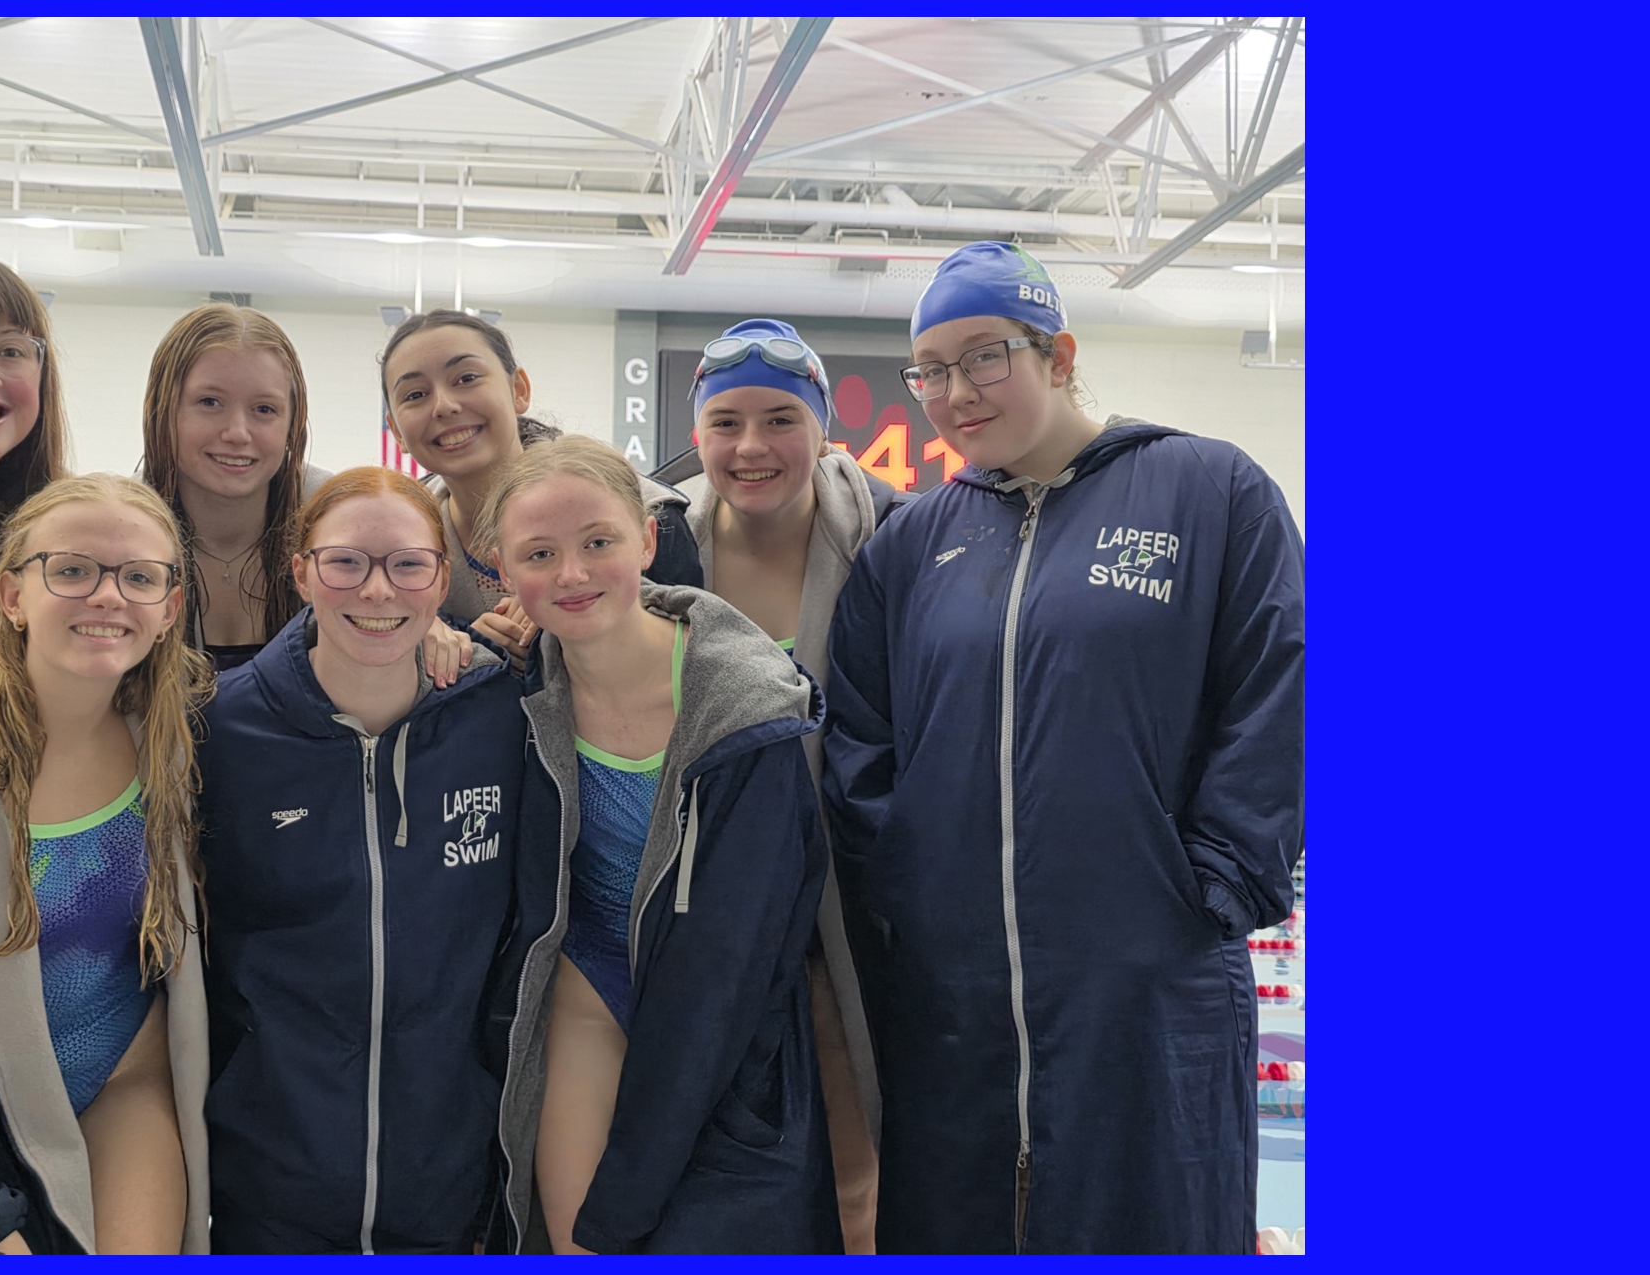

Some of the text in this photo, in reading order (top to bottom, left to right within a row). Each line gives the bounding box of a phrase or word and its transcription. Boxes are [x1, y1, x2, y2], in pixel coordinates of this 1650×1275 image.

[935, 546, 966, 561] speedo
[1096, 527, 1179, 564] LAPEER
[1088, 563, 1172, 603] SWIM
[271, 807, 308, 820] speedo
[443, 785, 501, 823] LAPEER
[443, 831, 499, 867] SWIM
